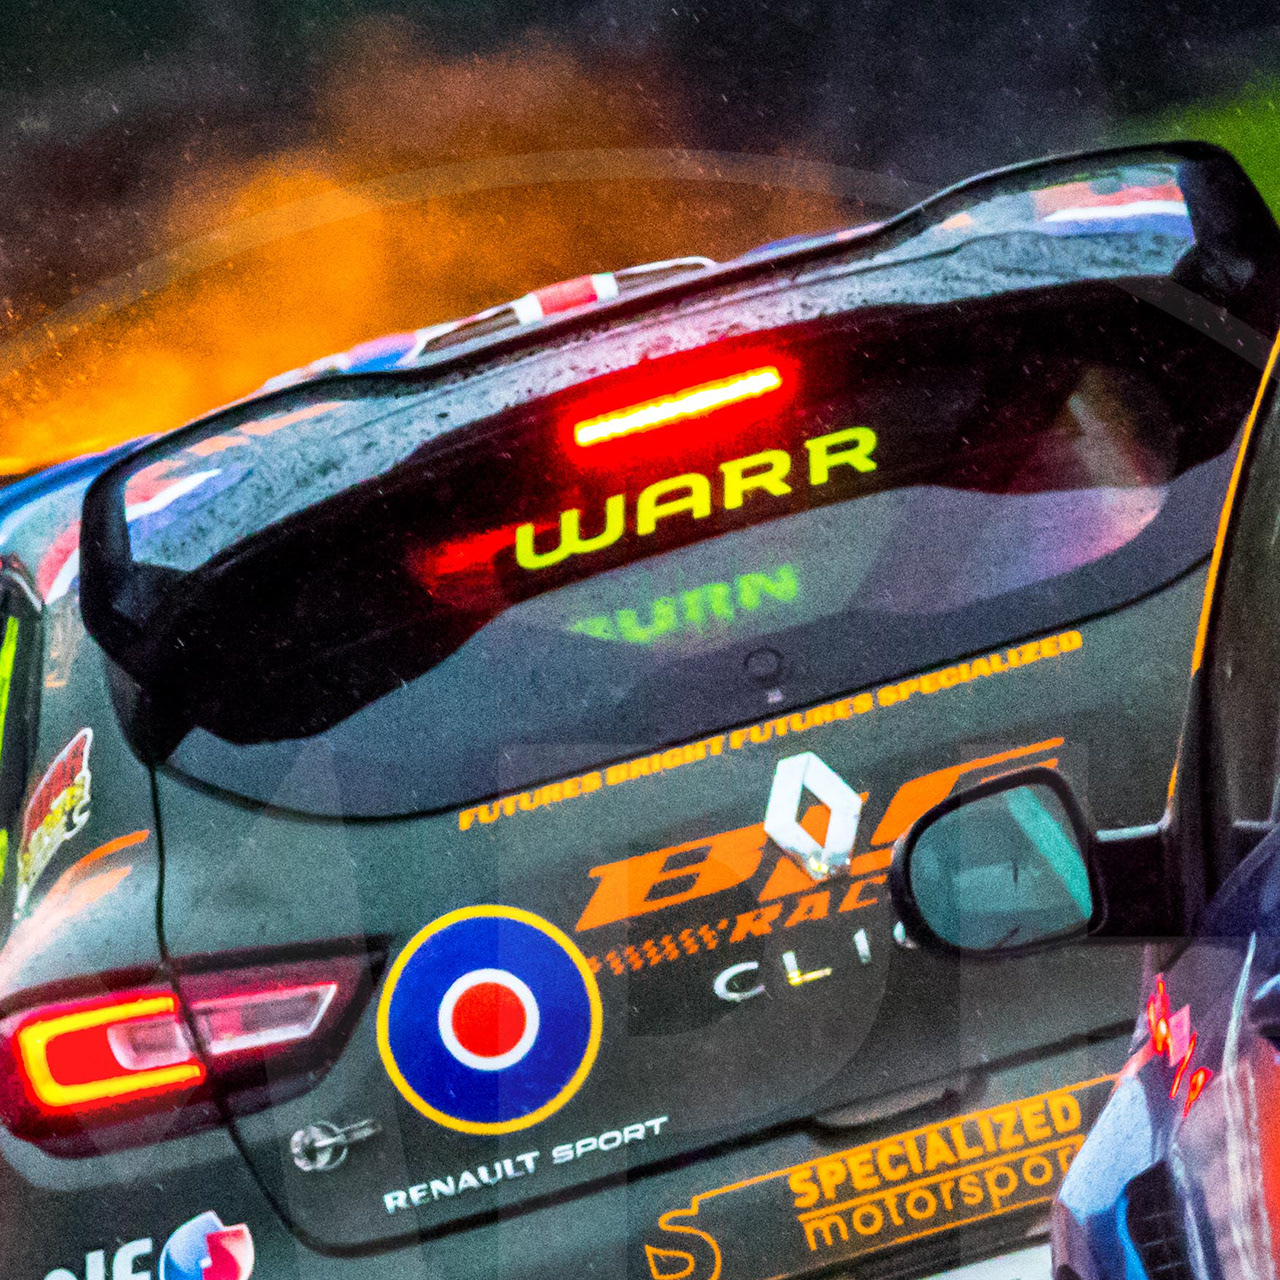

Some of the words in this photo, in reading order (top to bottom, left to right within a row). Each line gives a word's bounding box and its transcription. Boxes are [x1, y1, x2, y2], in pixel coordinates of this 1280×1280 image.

[515, 427, 877, 570] WARR
[458, 772, 602, 831] FUTURES
[606, 736, 724, 786] BRIGHT
[729, 693, 873, 748] FUTURES
[877, 631, 1083, 706] SPECIALIZED
[383, 1151, 540, 1214] RENAULT
[552, 1116, 668, 1165] SPORT
[787, 1095, 1082, 1208] SPECIALIZED
